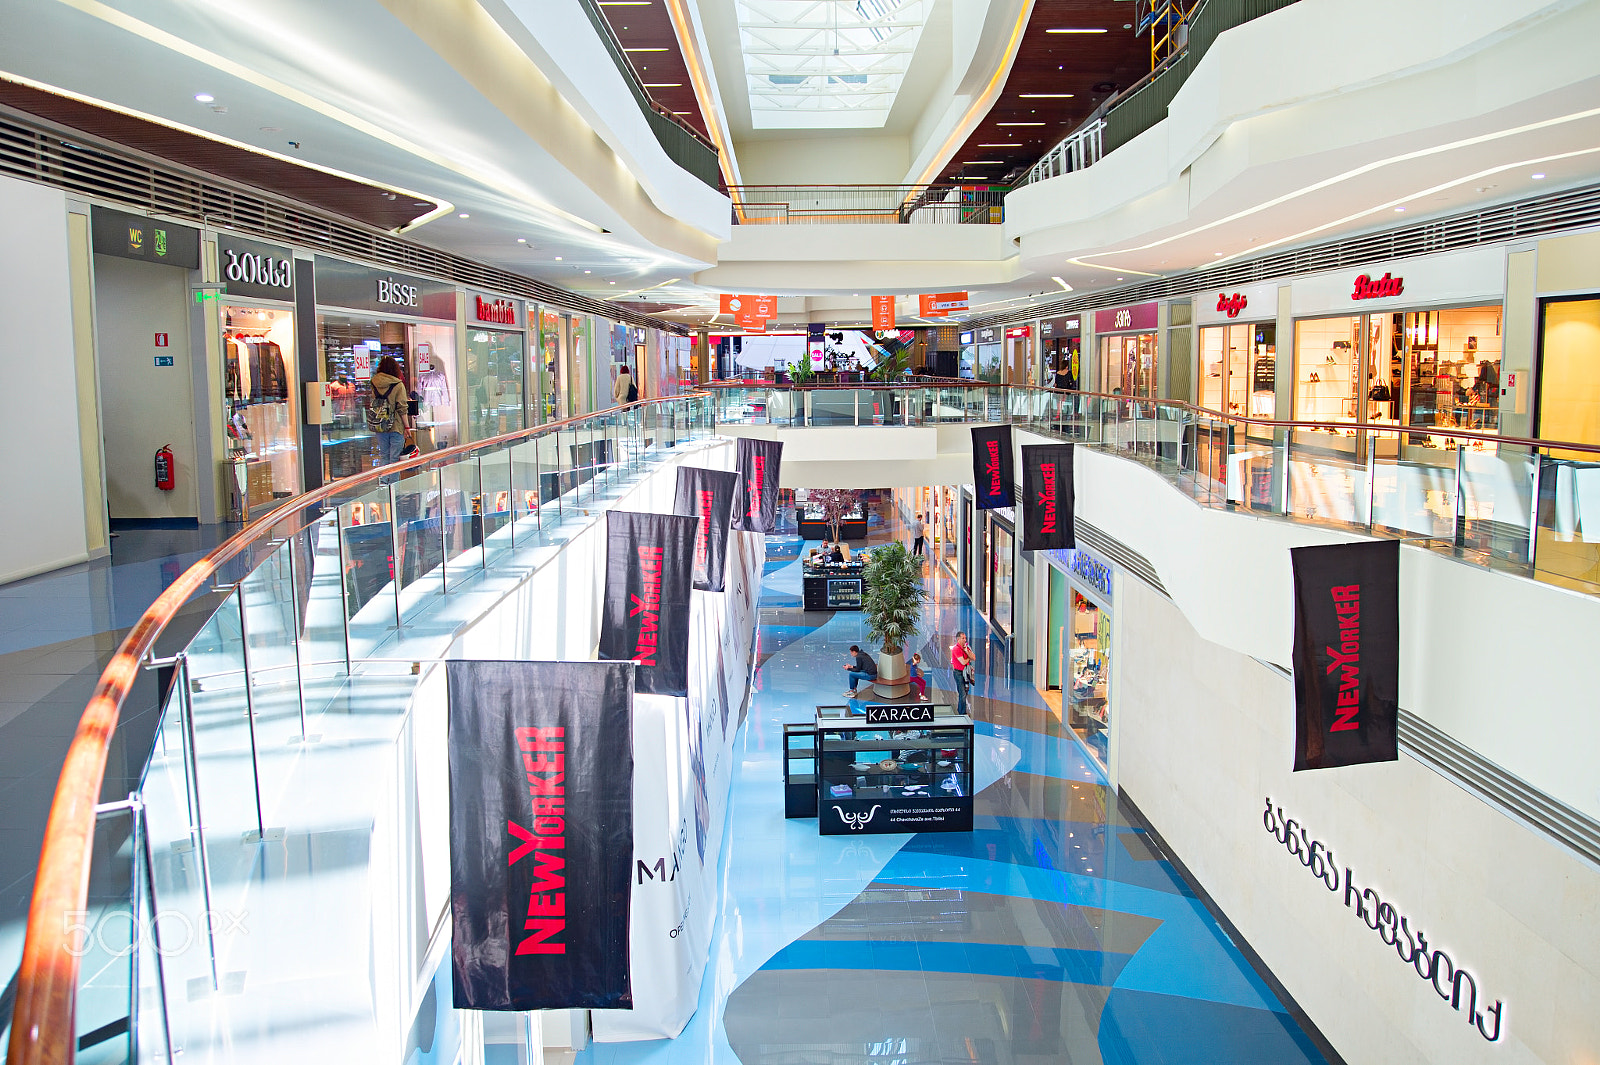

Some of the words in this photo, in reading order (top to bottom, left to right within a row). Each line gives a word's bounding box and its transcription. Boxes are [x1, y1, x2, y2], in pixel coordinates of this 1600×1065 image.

[129, 228, 143, 243] WC
[225, 249, 291, 288] ბისსე
[1351, 272, 1404, 300] Bata
[475, 295, 516, 325] bambini
[356, 356, 369, 369] SALE
[419, 352, 429, 364] SALE
[868, 707, 932, 721] KARACA
[1263, 797, 1339, 892] ბანანა
